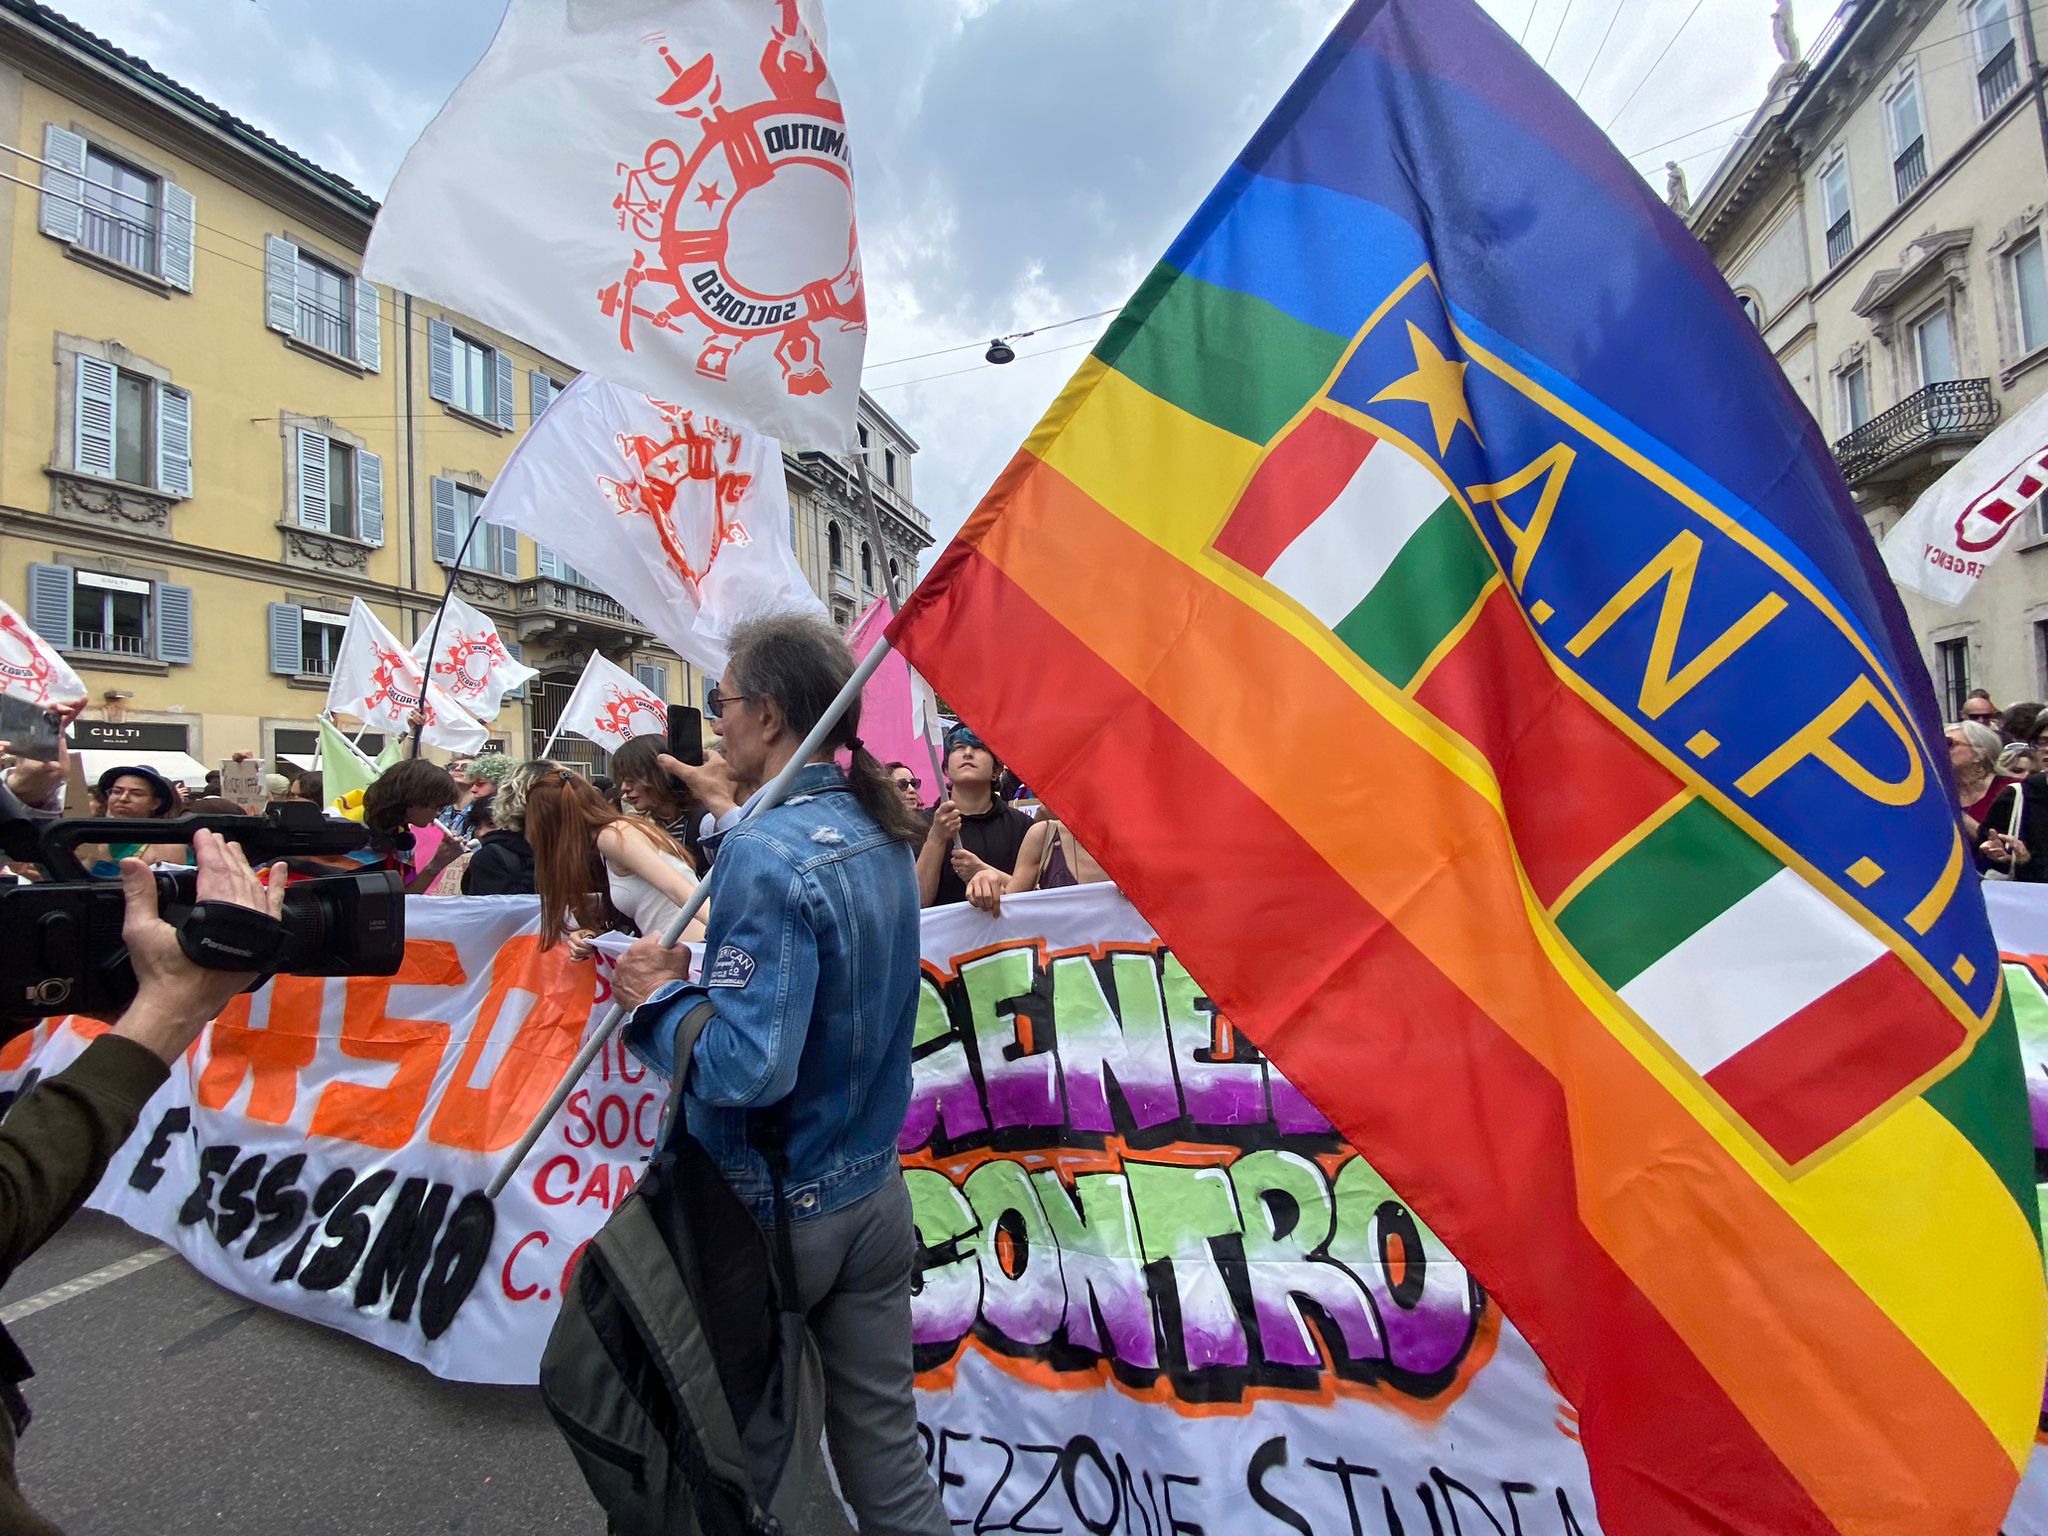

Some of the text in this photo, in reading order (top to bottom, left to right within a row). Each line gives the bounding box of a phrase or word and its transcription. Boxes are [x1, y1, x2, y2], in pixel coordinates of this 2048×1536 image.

[387, 687, 422, 706] SOCCORS
[1466, 441, 1976, 986] A.N.P.I.
[90, 727, 140, 737] CULTI
[200, 936, 253, 958] Panasonic
[564, 1088, 670, 1149] SOC
[129, 1106, 191, 1193] E
[901, 1148, 1497, 1396] CONTRO
